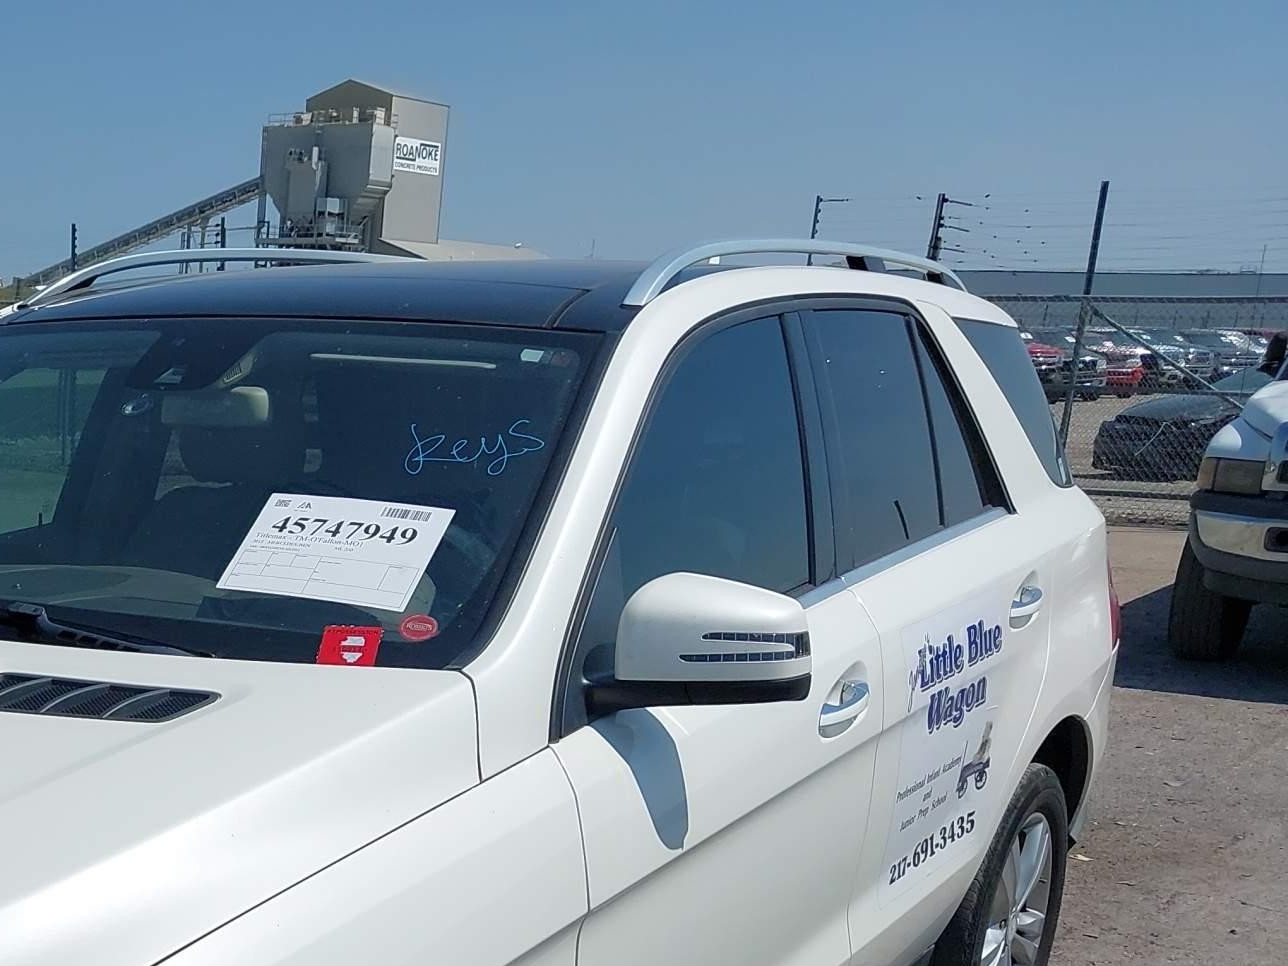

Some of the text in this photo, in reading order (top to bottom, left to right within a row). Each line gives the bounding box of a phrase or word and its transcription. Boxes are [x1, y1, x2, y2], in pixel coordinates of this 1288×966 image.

[396, 143, 440, 161] ROANOKE
[272, 516, 418, 546] 45747949
[918, 619, 1002, 692] Little Blue
[928, 676, 987, 734] Wagon
[889, 810, 976, 885] 217-691-3435
